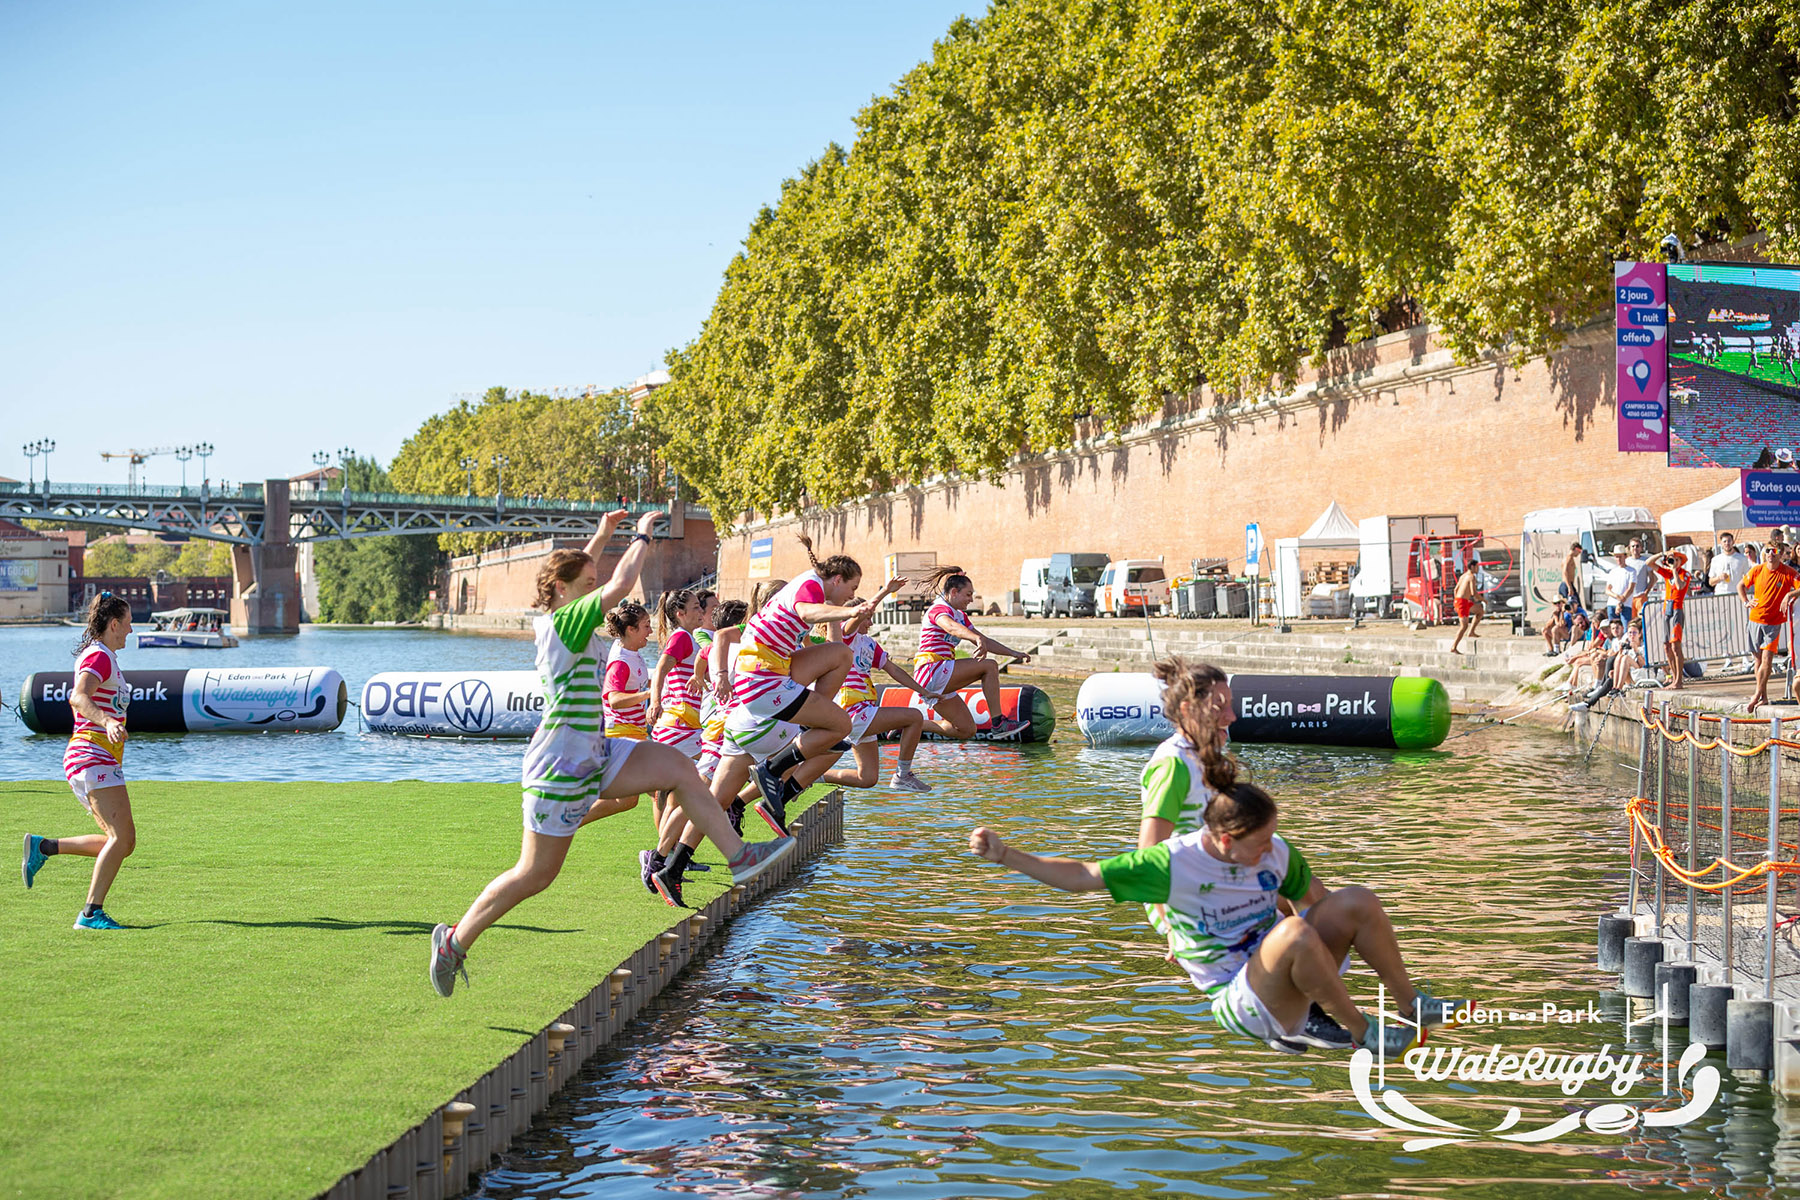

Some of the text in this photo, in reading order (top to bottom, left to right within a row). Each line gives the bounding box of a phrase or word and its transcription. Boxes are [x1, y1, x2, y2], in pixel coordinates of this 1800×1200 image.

[1620, 289, 1648, 302] 2 jours
[1637, 311, 1659, 322] 1 nuit
[1622, 332, 1651, 343] offerte
[1755, 481, 1783, 492] Portes
[264, 672, 287, 680] Park
[1242, 691, 1376, 718] Eden Park
[370, 723, 446, 733] automobiles
